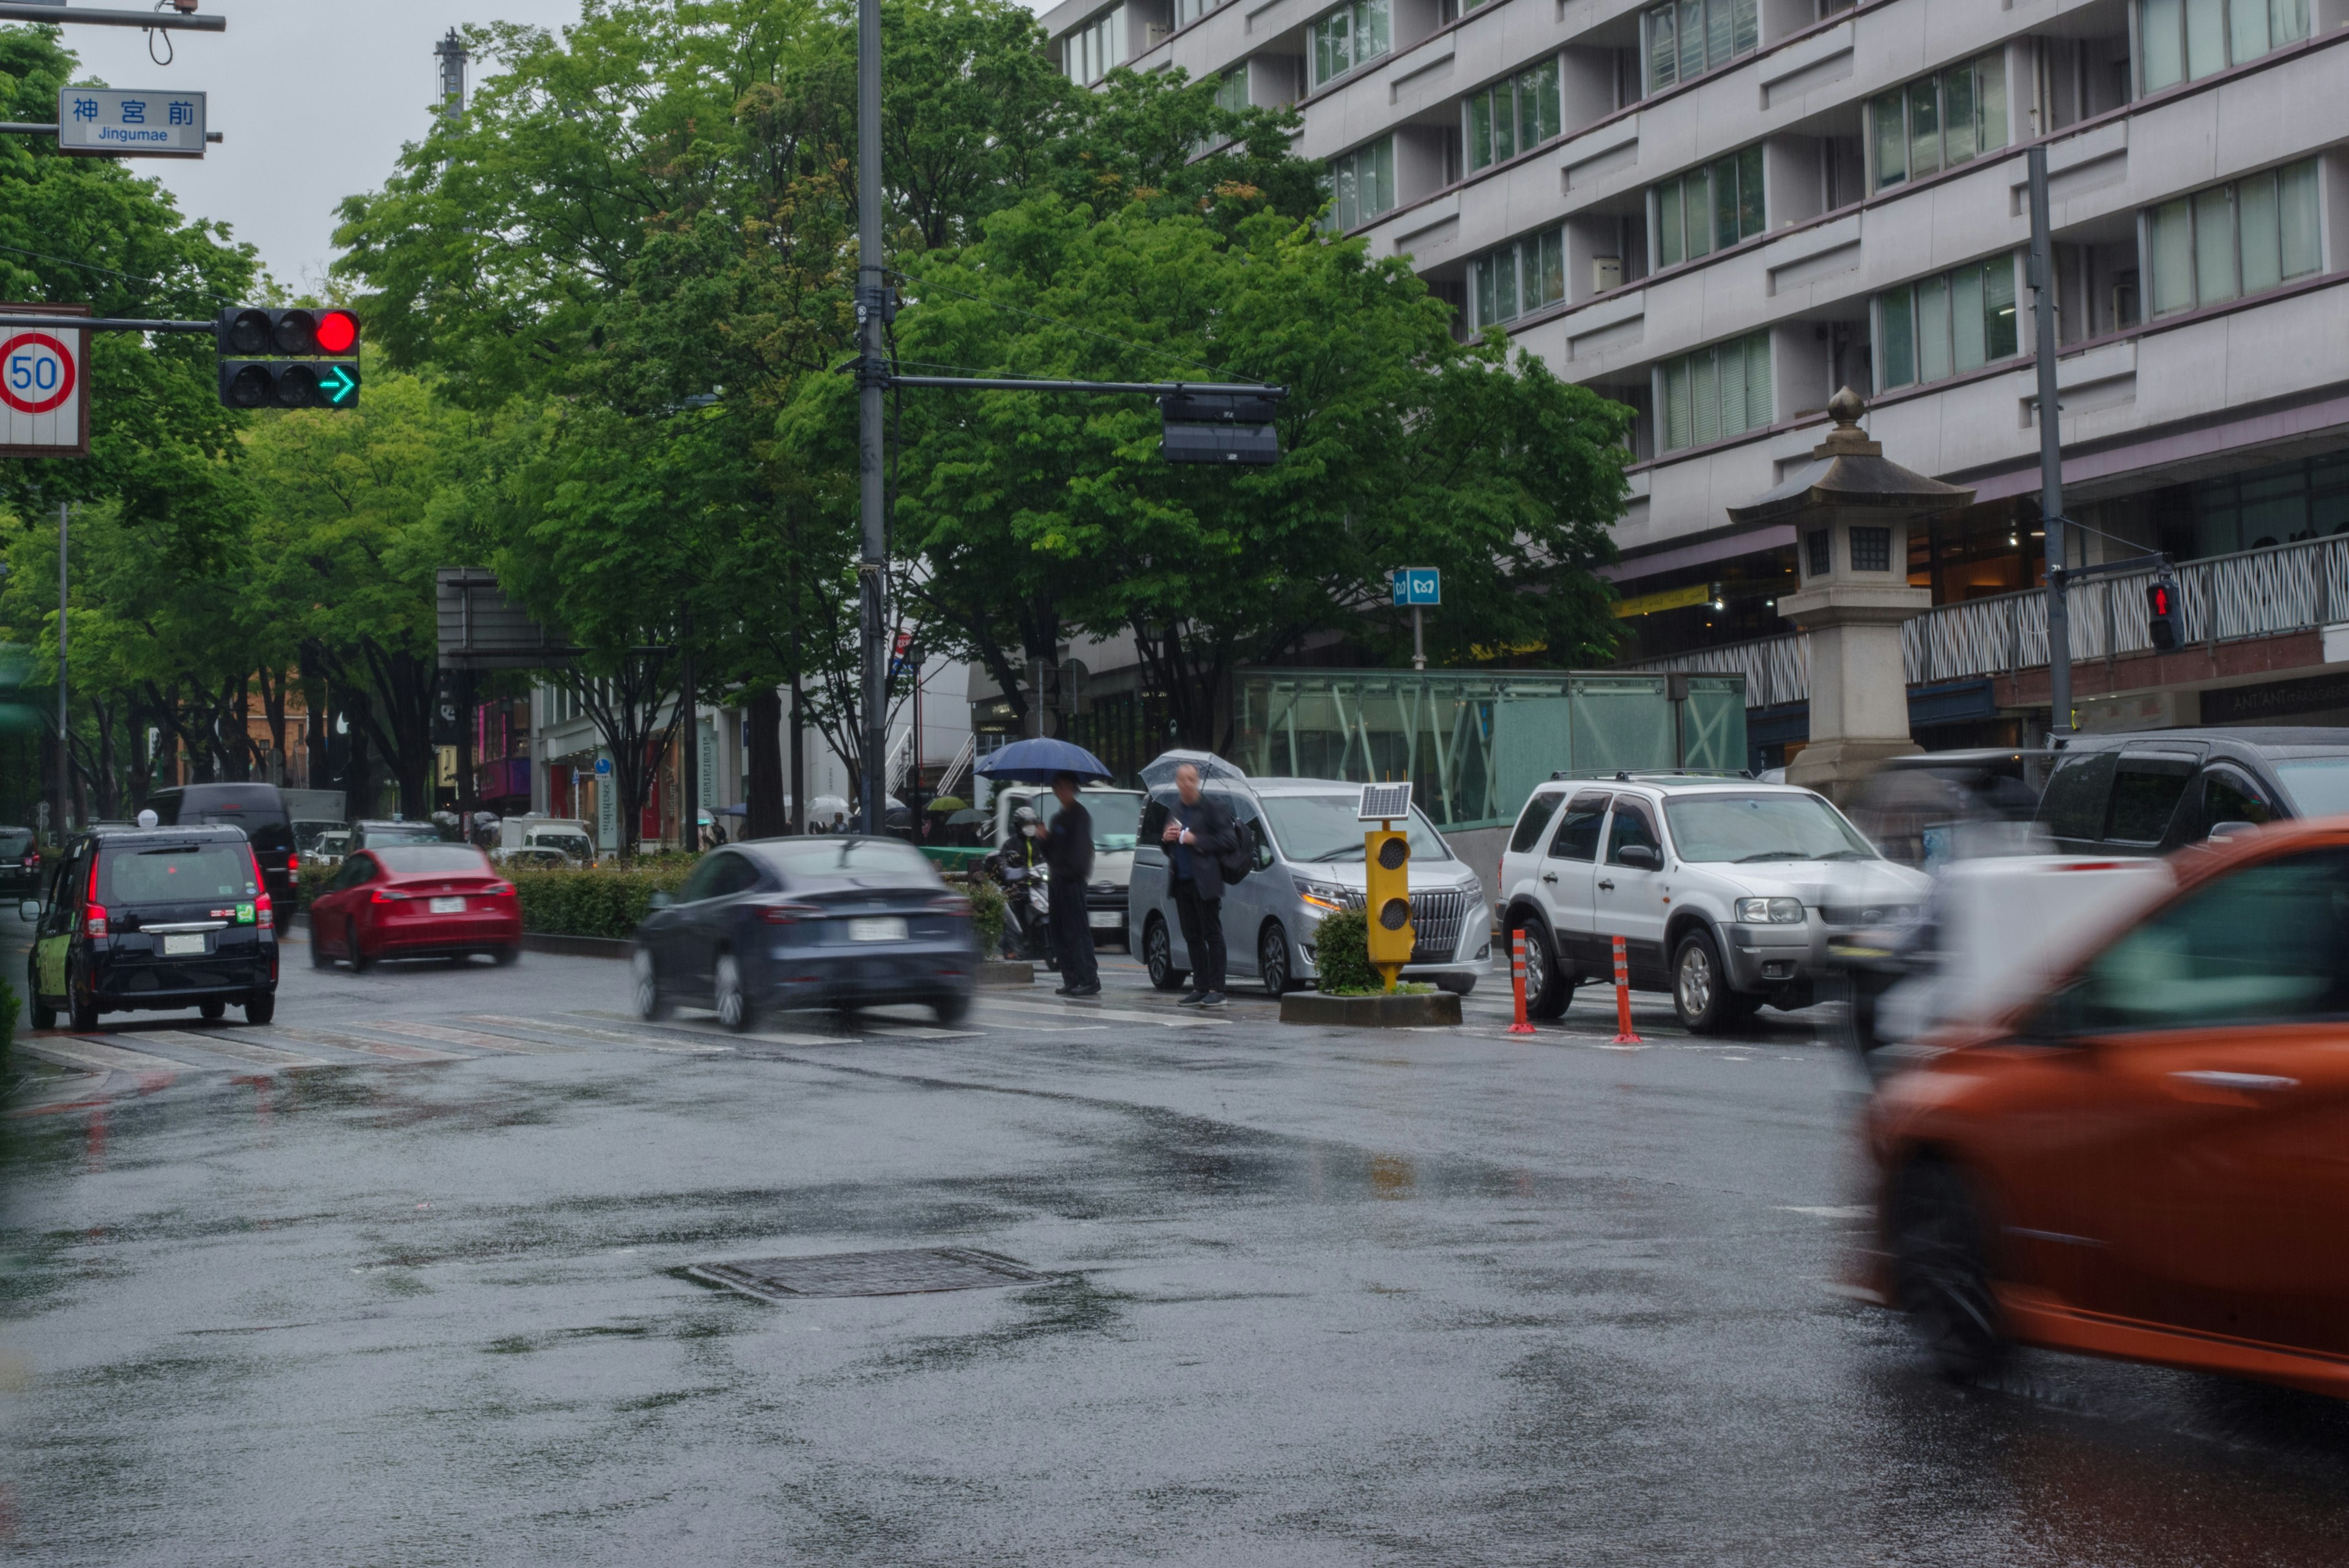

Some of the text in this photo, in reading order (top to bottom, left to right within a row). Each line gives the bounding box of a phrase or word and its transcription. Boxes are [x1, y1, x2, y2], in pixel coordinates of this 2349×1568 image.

[73, 97, 193, 125] 神宮前
[98, 127, 168, 142] Jingumae
[12, 356, 56, 390] 50
